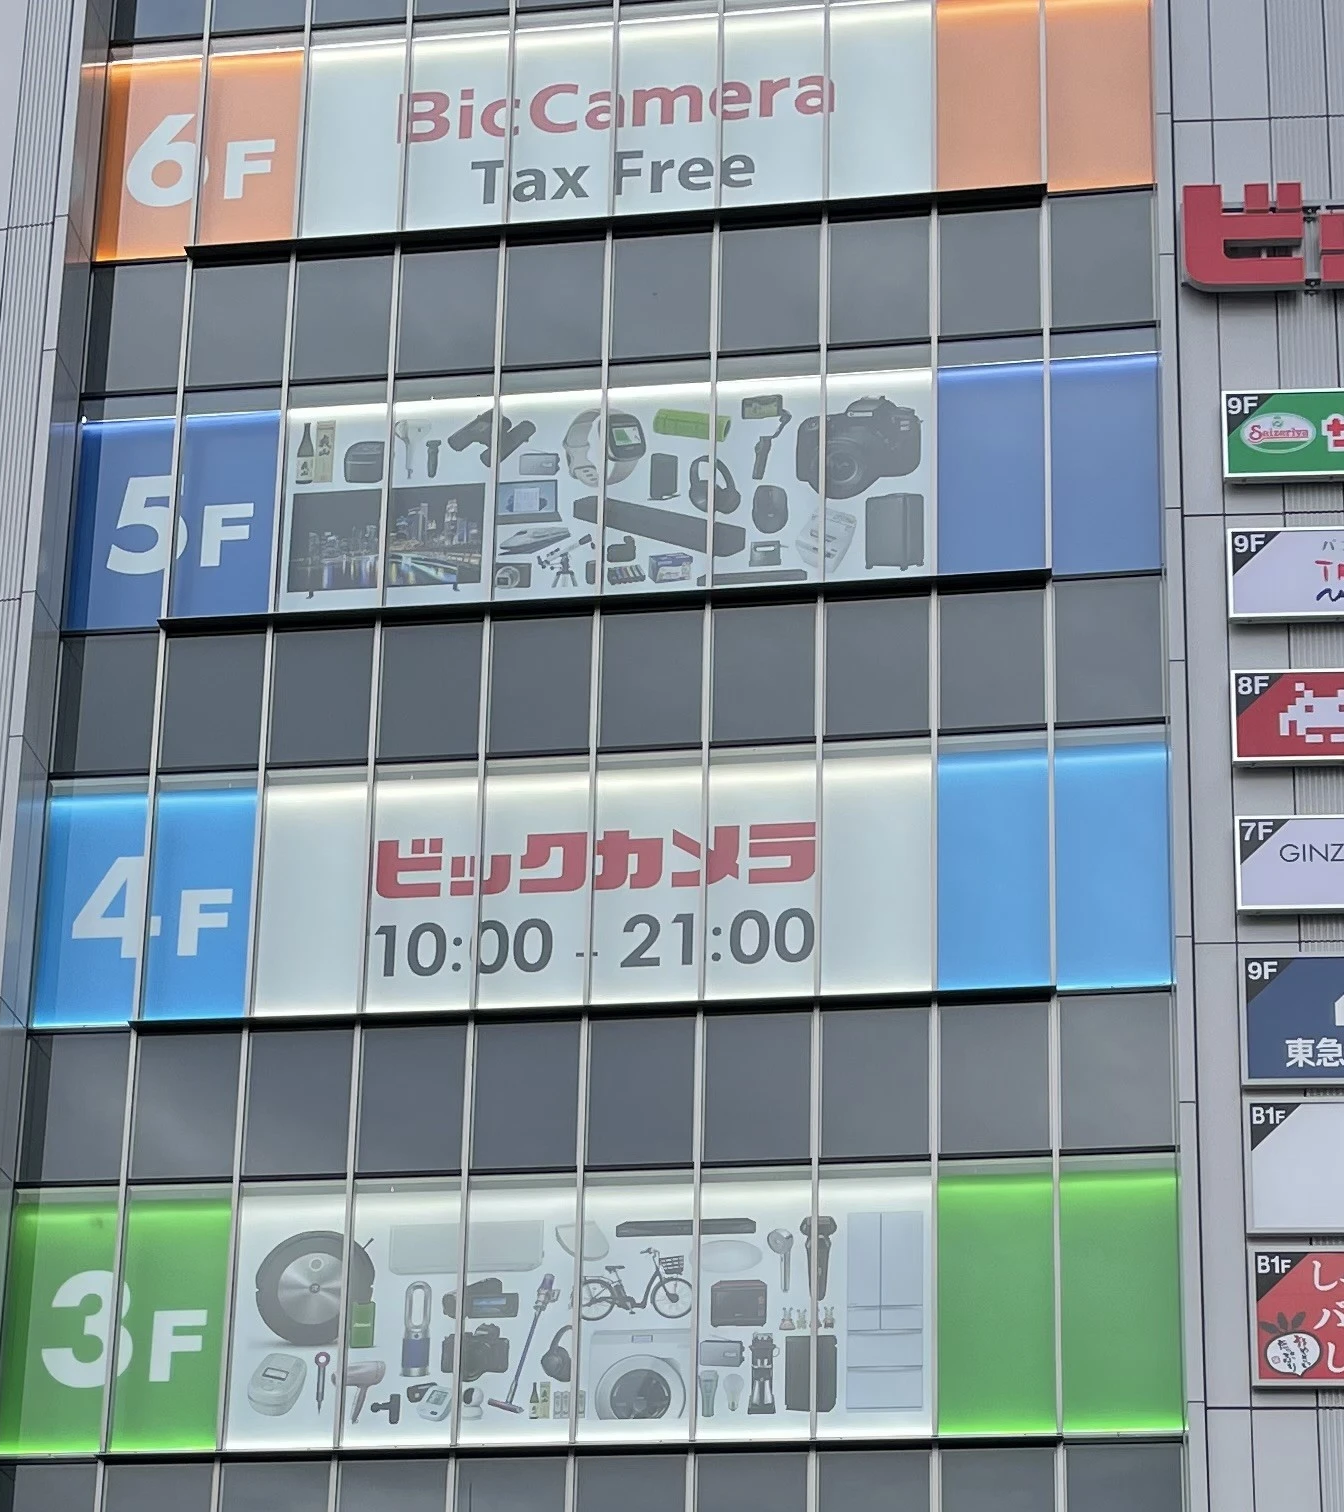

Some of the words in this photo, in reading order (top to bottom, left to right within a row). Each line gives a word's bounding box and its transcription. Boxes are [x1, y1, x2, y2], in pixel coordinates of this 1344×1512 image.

[398, 73, 836, 144] BicCamera
[126, 114, 275, 207] 6F
[470, 158, 590, 205] Tax
[612, 148, 755, 196] Free
[1227, 396, 1258, 415] 9F
[106, 474, 254, 575] 5F
[1233, 533, 1266, 553] 9F
[1237, 675, 1270, 695] 8F
[1240, 821, 1274, 841] 7F
[376, 821, 816, 900] ビックカメラ
[71, 857, 233, 959] 4F
[372, 918, 553, 978] 10:00
[620, 907, 816, 970] 21:00
[1247, 961, 1278, 980] 9F
[1252, 1107, 1286, 1125] B1F
[1257, 1255, 1291, 1274] B1F
[40, 1269, 209, 1389] 3F
